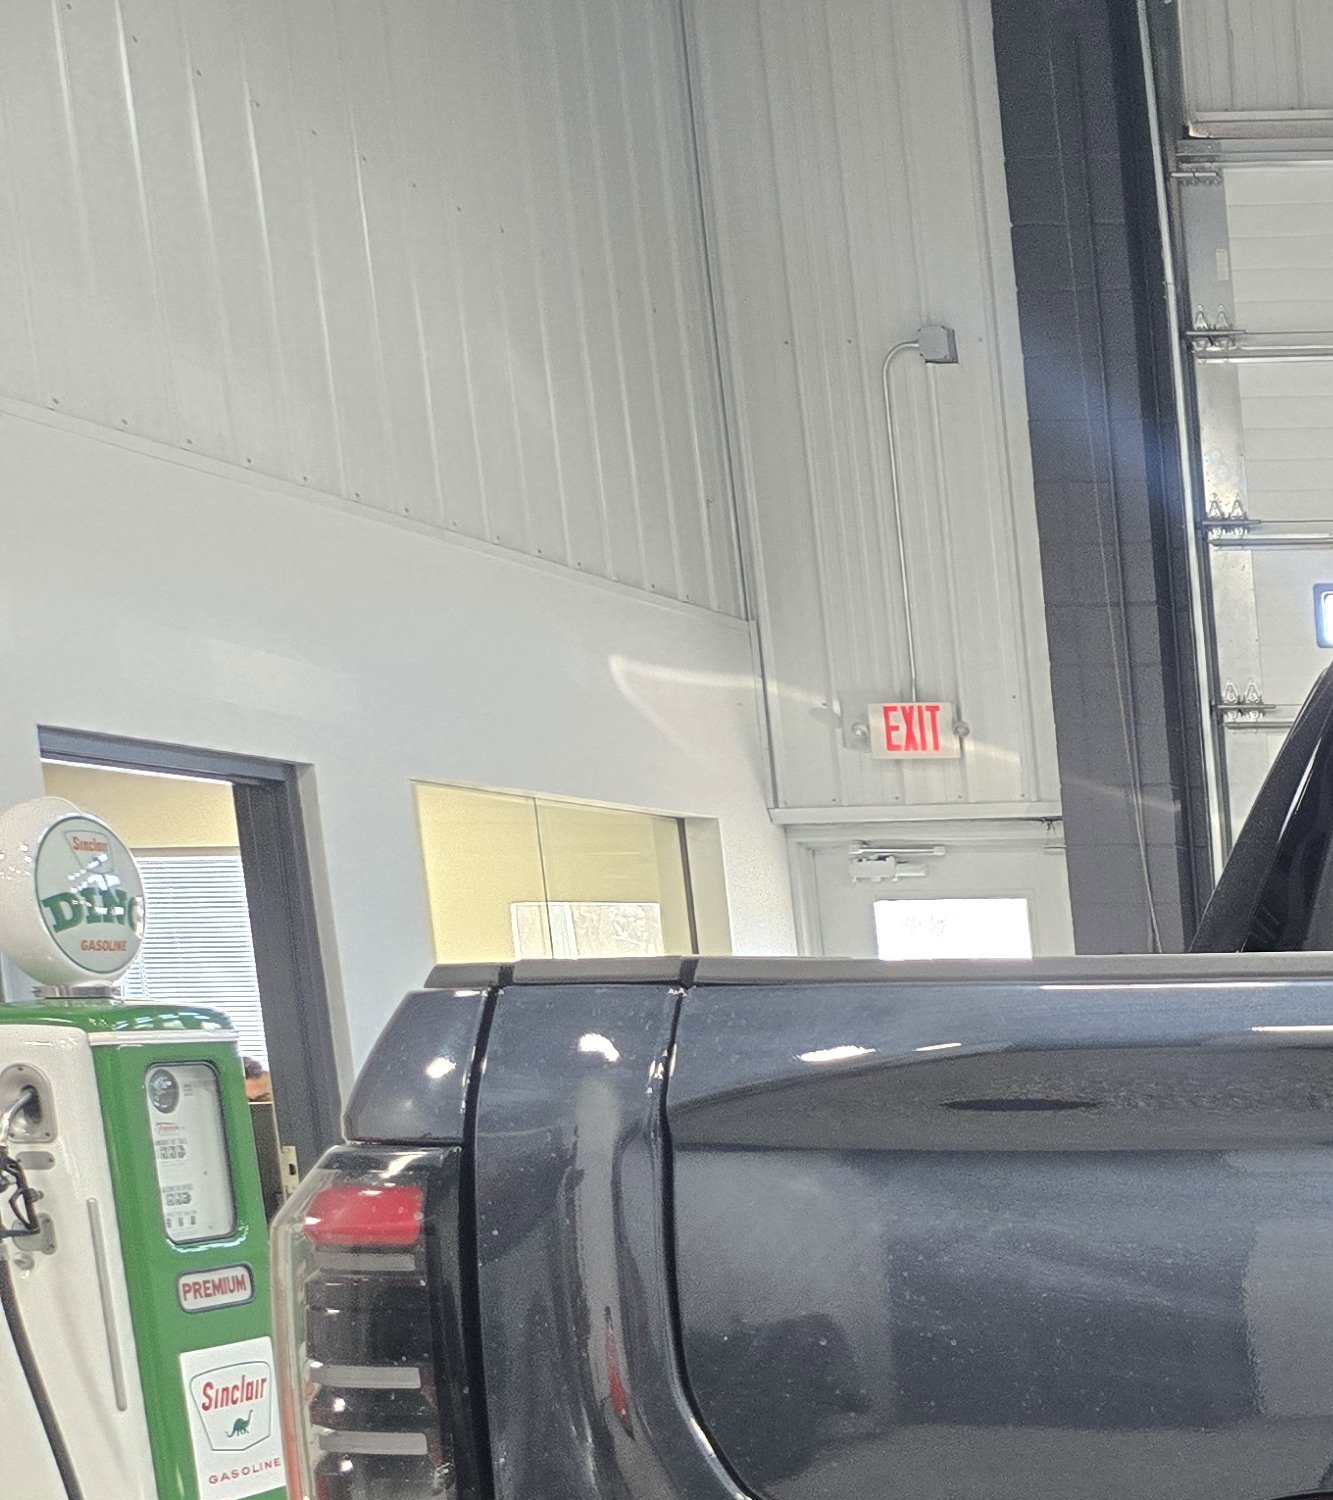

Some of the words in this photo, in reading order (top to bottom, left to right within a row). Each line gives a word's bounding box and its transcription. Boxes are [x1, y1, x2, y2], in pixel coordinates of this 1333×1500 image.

[882, 705, 940, 751] EXIT
[80, 940, 127, 951] GASOLINE
[182, 1274, 246, 1301] PREMIUM
[201, 1374, 267, 1412] Sinclair
[208, 1457, 282, 1484] GASOLINE
